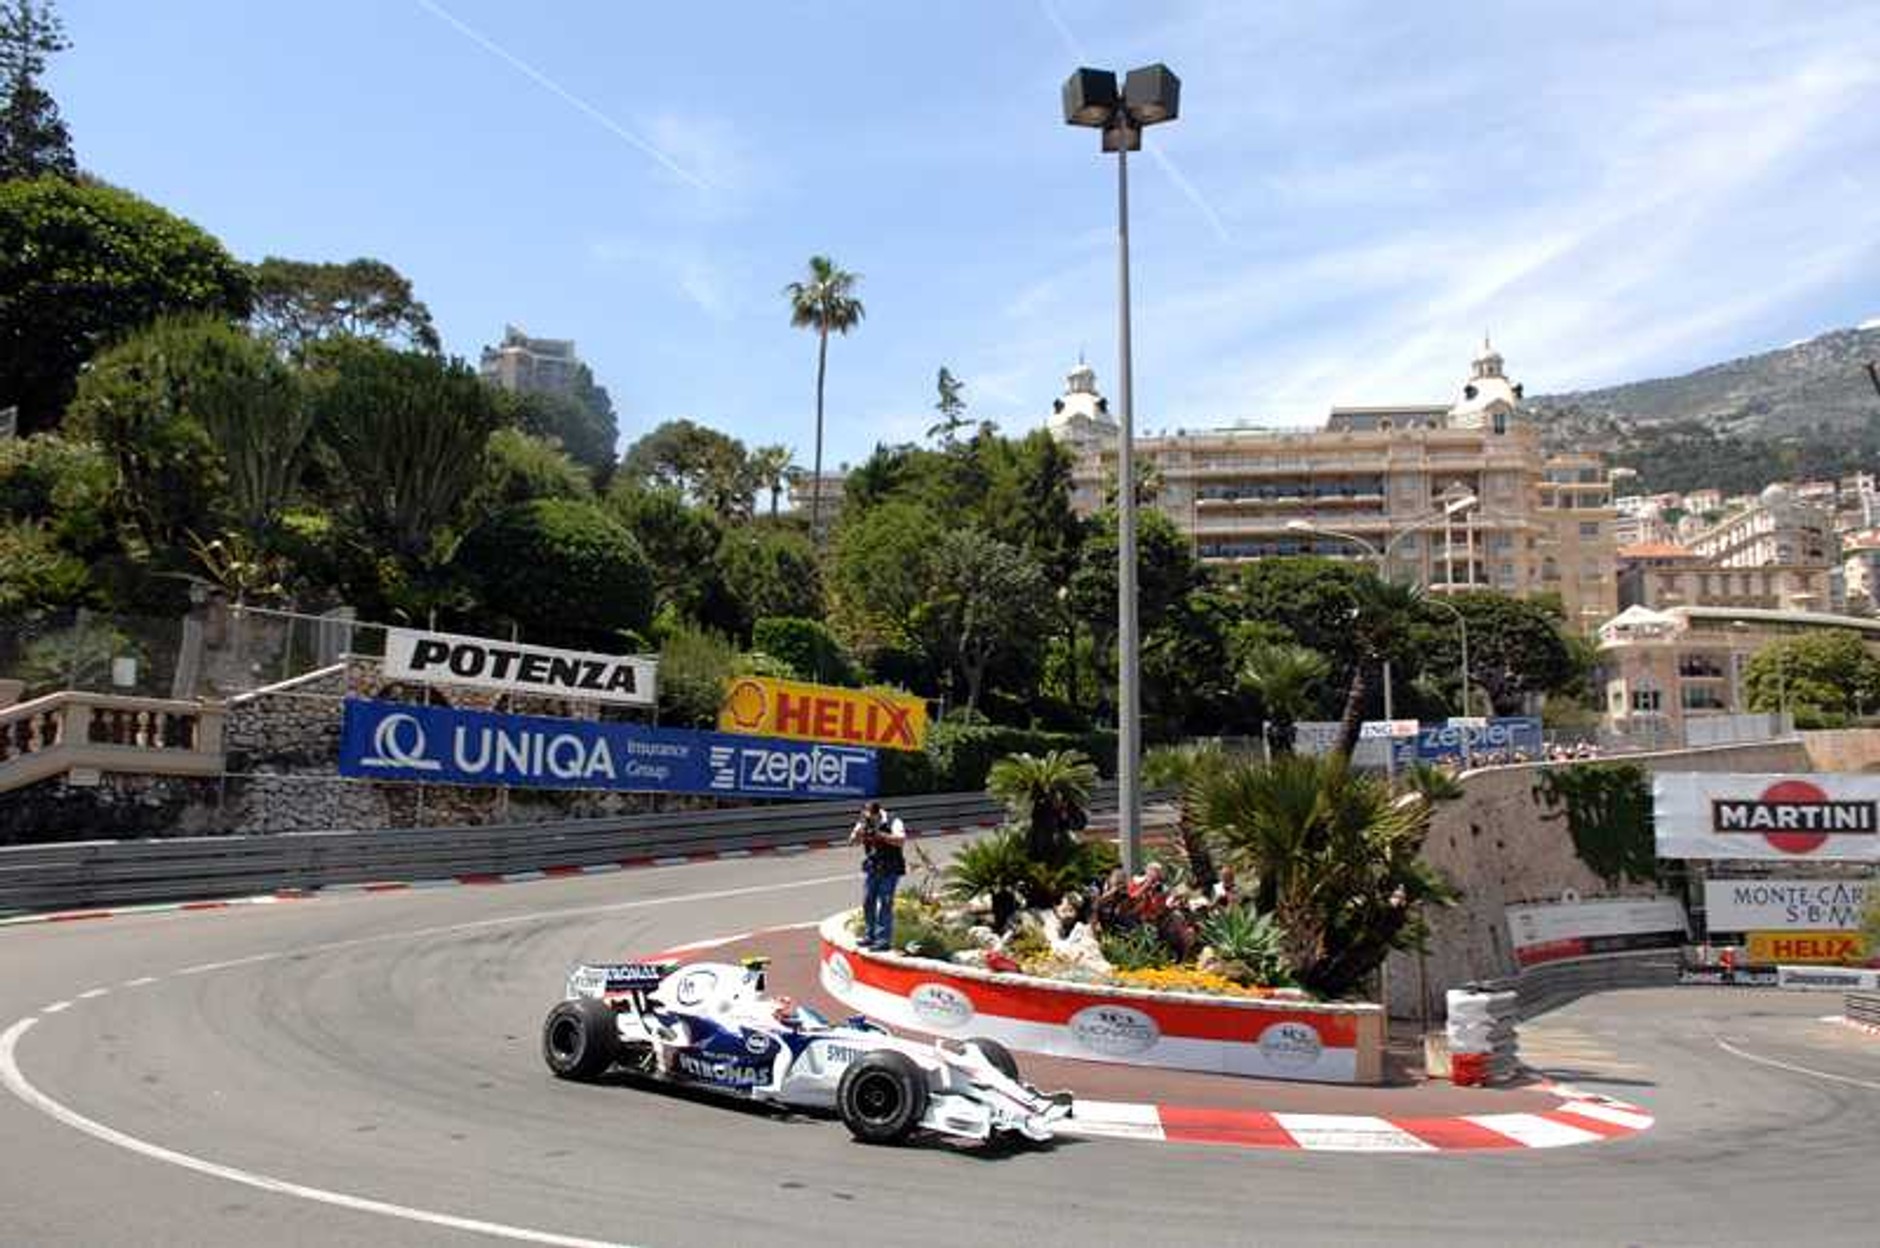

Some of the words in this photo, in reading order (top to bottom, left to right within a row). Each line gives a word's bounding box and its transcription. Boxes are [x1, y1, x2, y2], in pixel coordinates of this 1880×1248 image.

[410, 638, 637, 694] POTENZA
[774, 692, 918, 751] HELIX
[454, 725, 617, 779] UNIQA
[1719, 805, 1871, 830] MARTINI
